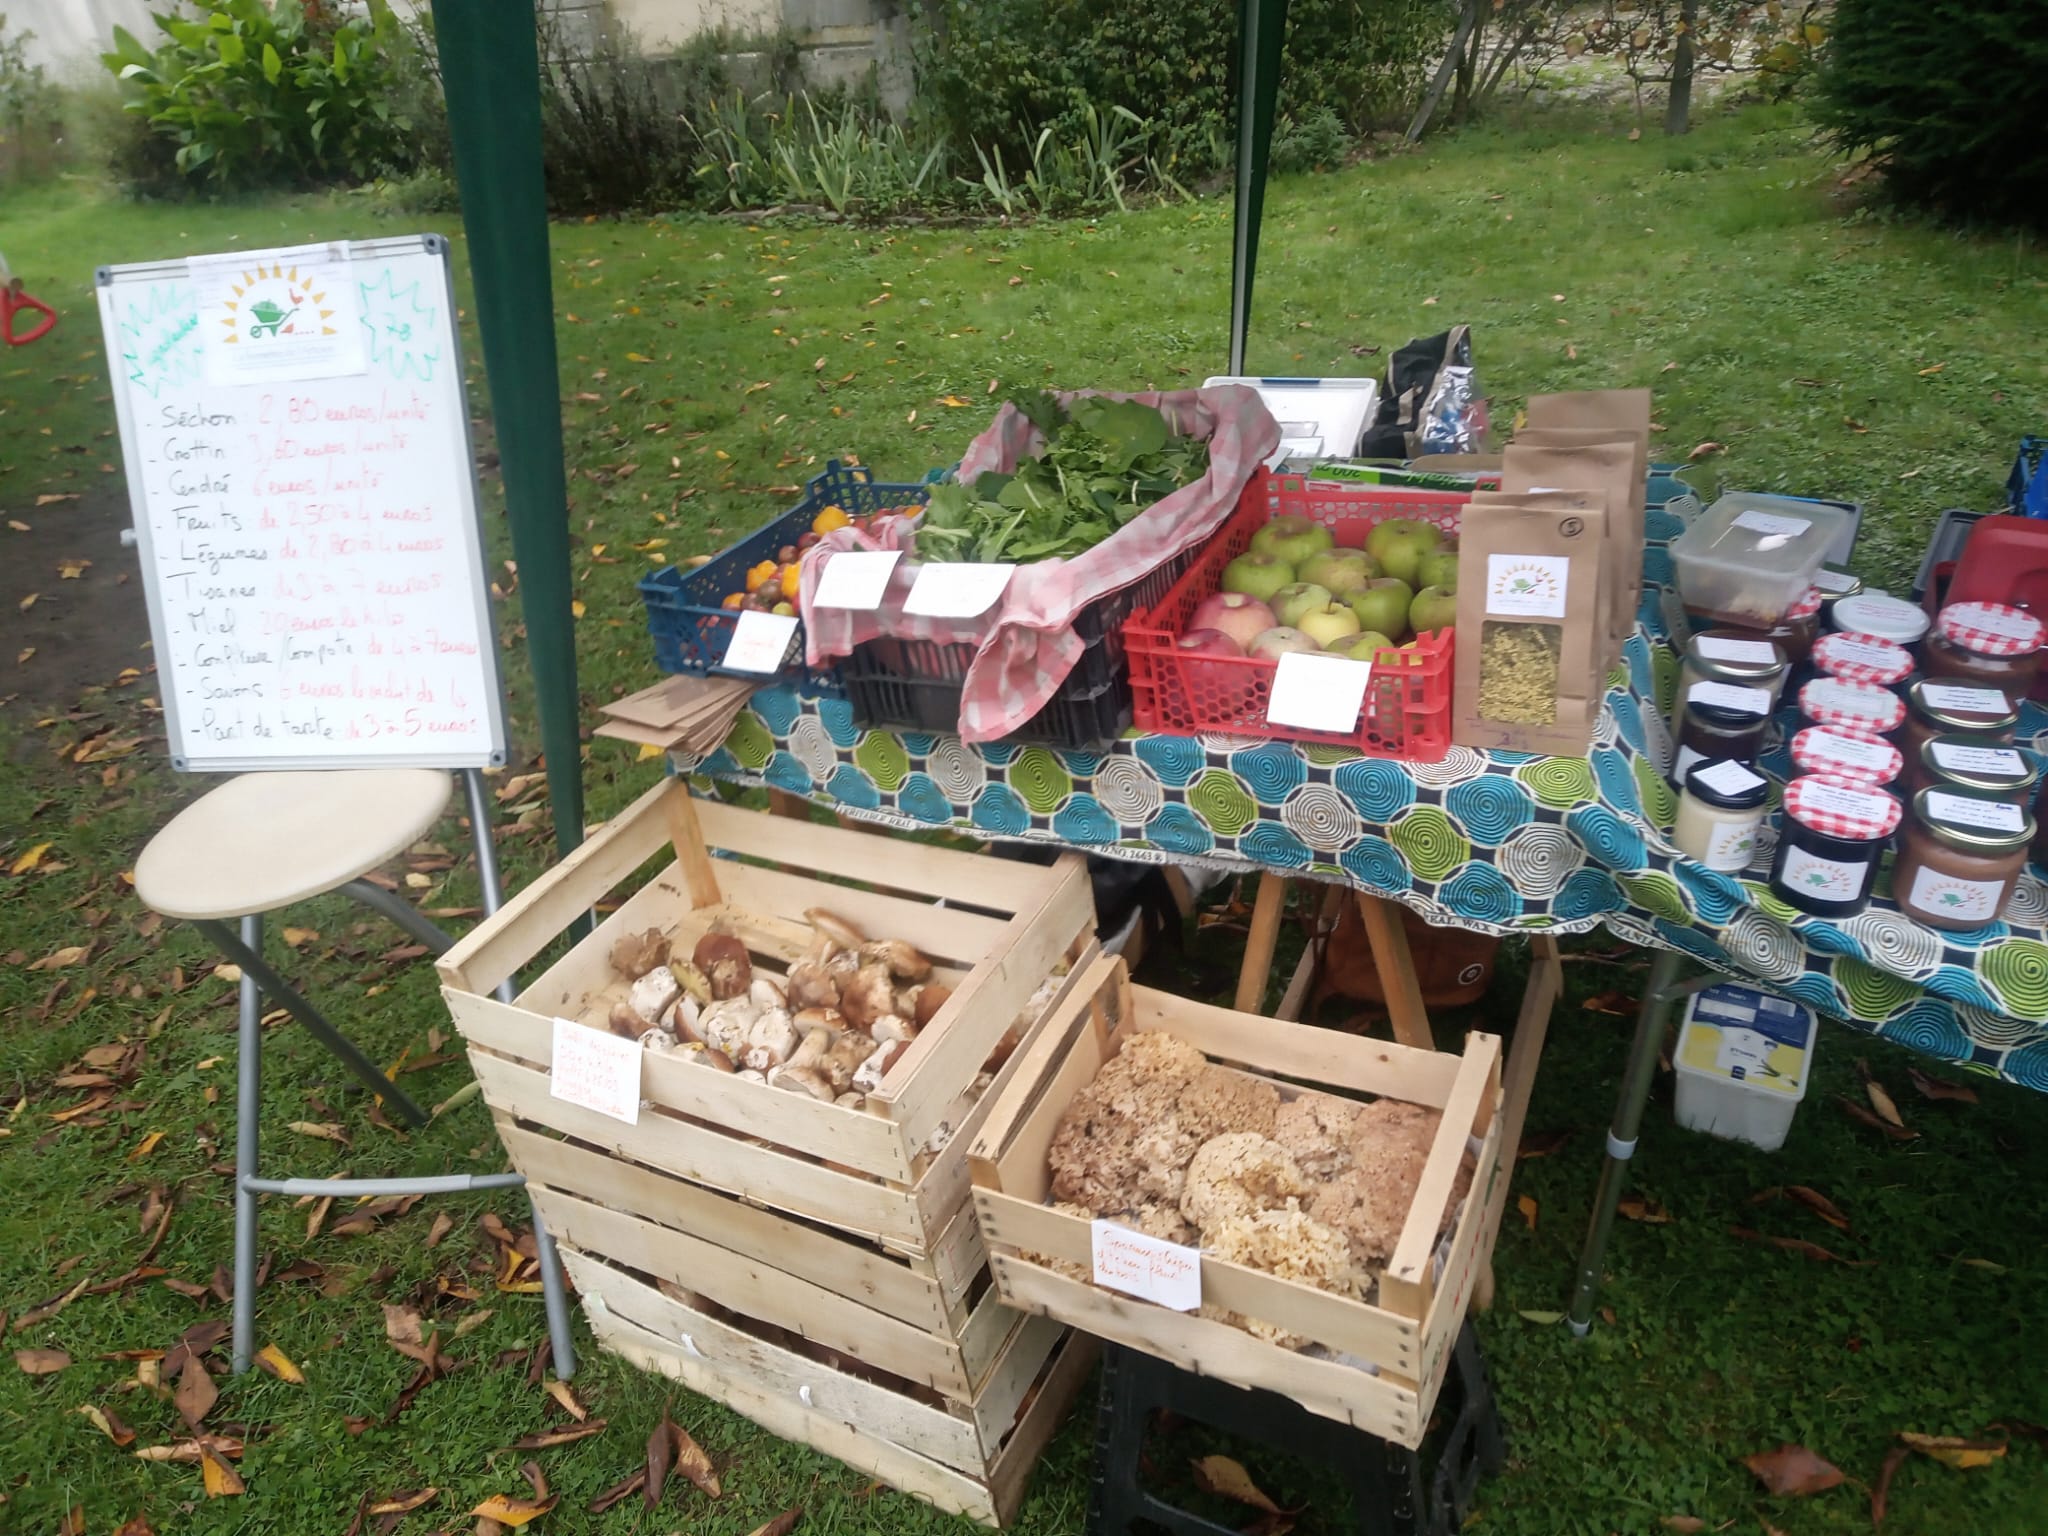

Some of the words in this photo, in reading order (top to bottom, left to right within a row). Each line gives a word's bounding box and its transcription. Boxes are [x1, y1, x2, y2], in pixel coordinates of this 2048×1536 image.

[163, 436, 225, 462] Crottin
[168, 468, 231, 497] Cendré
[171, 500, 242, 532] Fruits
[261, 506, 280, 528] de
[382, 505, 433, 522] euros
[180, 537, 268, 576] Légumes
[280, 536, 299, 559] de
[397, 537, 445, 552] euros
[375, 573, 443, 595] euros
[187, 606, 237, 637] Miel
[290, 616, 335, 632] euros
[367, 631, 384, 656] de
[199, 676, 264, 701] Savons
[299, 681, 345, 699] euros
[417, 676, 435, 704] de
[202, 706, 244, 742] Part
[253, 711, 273, 738] de
[280, 706, 334, 740] tarte
[363, 712, 381, 739] 3
[403, 707, 424, 737] 5
[427, 717, 477, 735] euros
